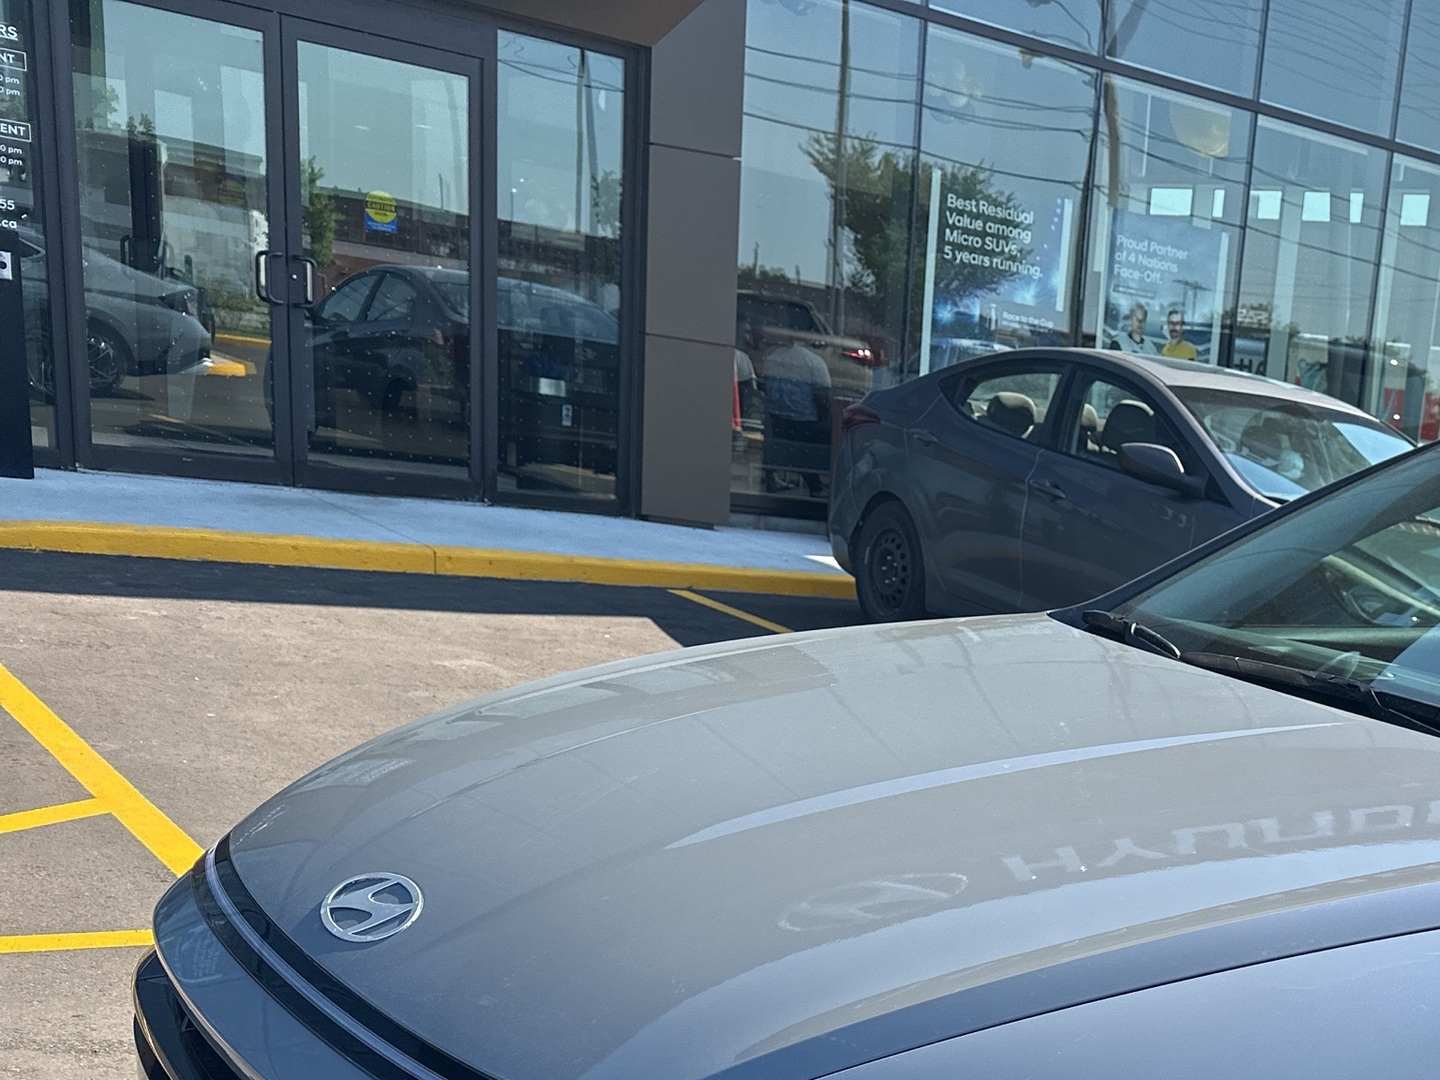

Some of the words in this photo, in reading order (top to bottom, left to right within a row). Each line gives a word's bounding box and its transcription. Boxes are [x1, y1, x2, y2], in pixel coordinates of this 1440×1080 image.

[5, 76, 20, 85] pm
[6, 88, 20, 97] pm
[8, 146, 23, 155] pm
[8, 157, 23, 166] pm
[947, 193, 977, 213] Best
[979, 201, 1034, 224] Residual
[946, 210, 983, 231] Value
[985, 221, 1032, 244] among
[945, 228, 982, 248] Micro
[984, 236, 1021, 257] SUVs,
[1116, 234, 1148, 252] Proud
[1149, 241, 1189, 260] Partner
[943, 245, 953, 259] 5
[954, 249, 991, 268] years
[992, 257, 1044, 279] running.
[1115, 250, 1127, 261] of
[1127, 252, 1136, 263] 4
[1138, 254, 1178, 273] Nations
[1113, 264, 1163, 284] Face-Off.
[1002, 311, 1020, 322] Race
[1028, 316, 1040, 325] the
[1040, 318, 1055, 329] Cup
